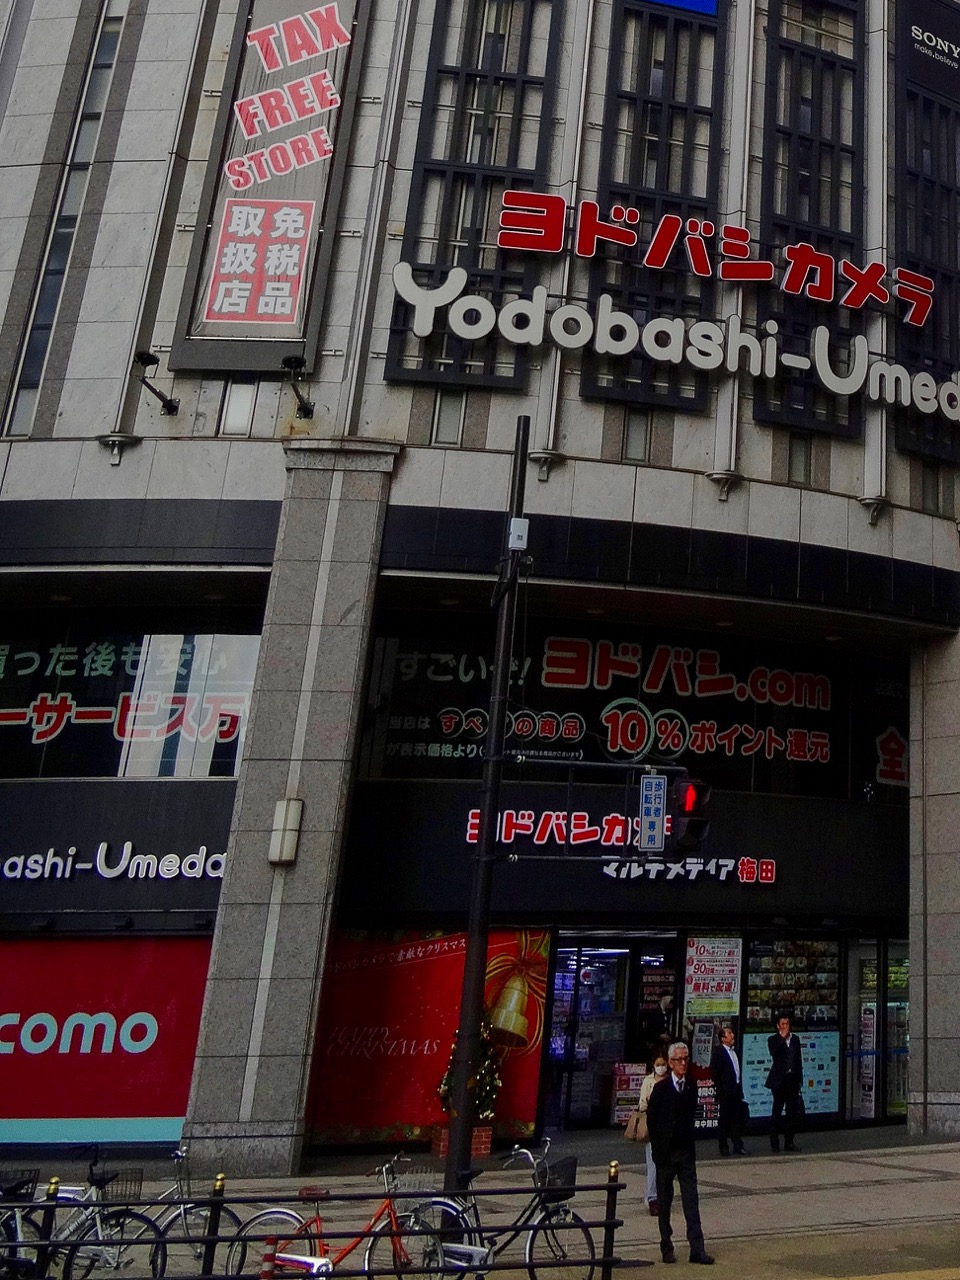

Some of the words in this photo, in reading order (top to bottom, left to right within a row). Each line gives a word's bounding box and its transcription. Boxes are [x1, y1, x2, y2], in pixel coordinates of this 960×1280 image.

[246, 2, 351, 74] TAX
[234, 69, 341, 140] FREE
[225, 125, 333, 192] STORE
[497, 189, 935, 327] ヨドバシカメラ
[541, 637, 830, 710] ヨドバシ.com
[439, 712, 580, 738] すべの商品
[643, 781, 653, 818] 自転車
[654, 781, 663, 818] 歩行者
